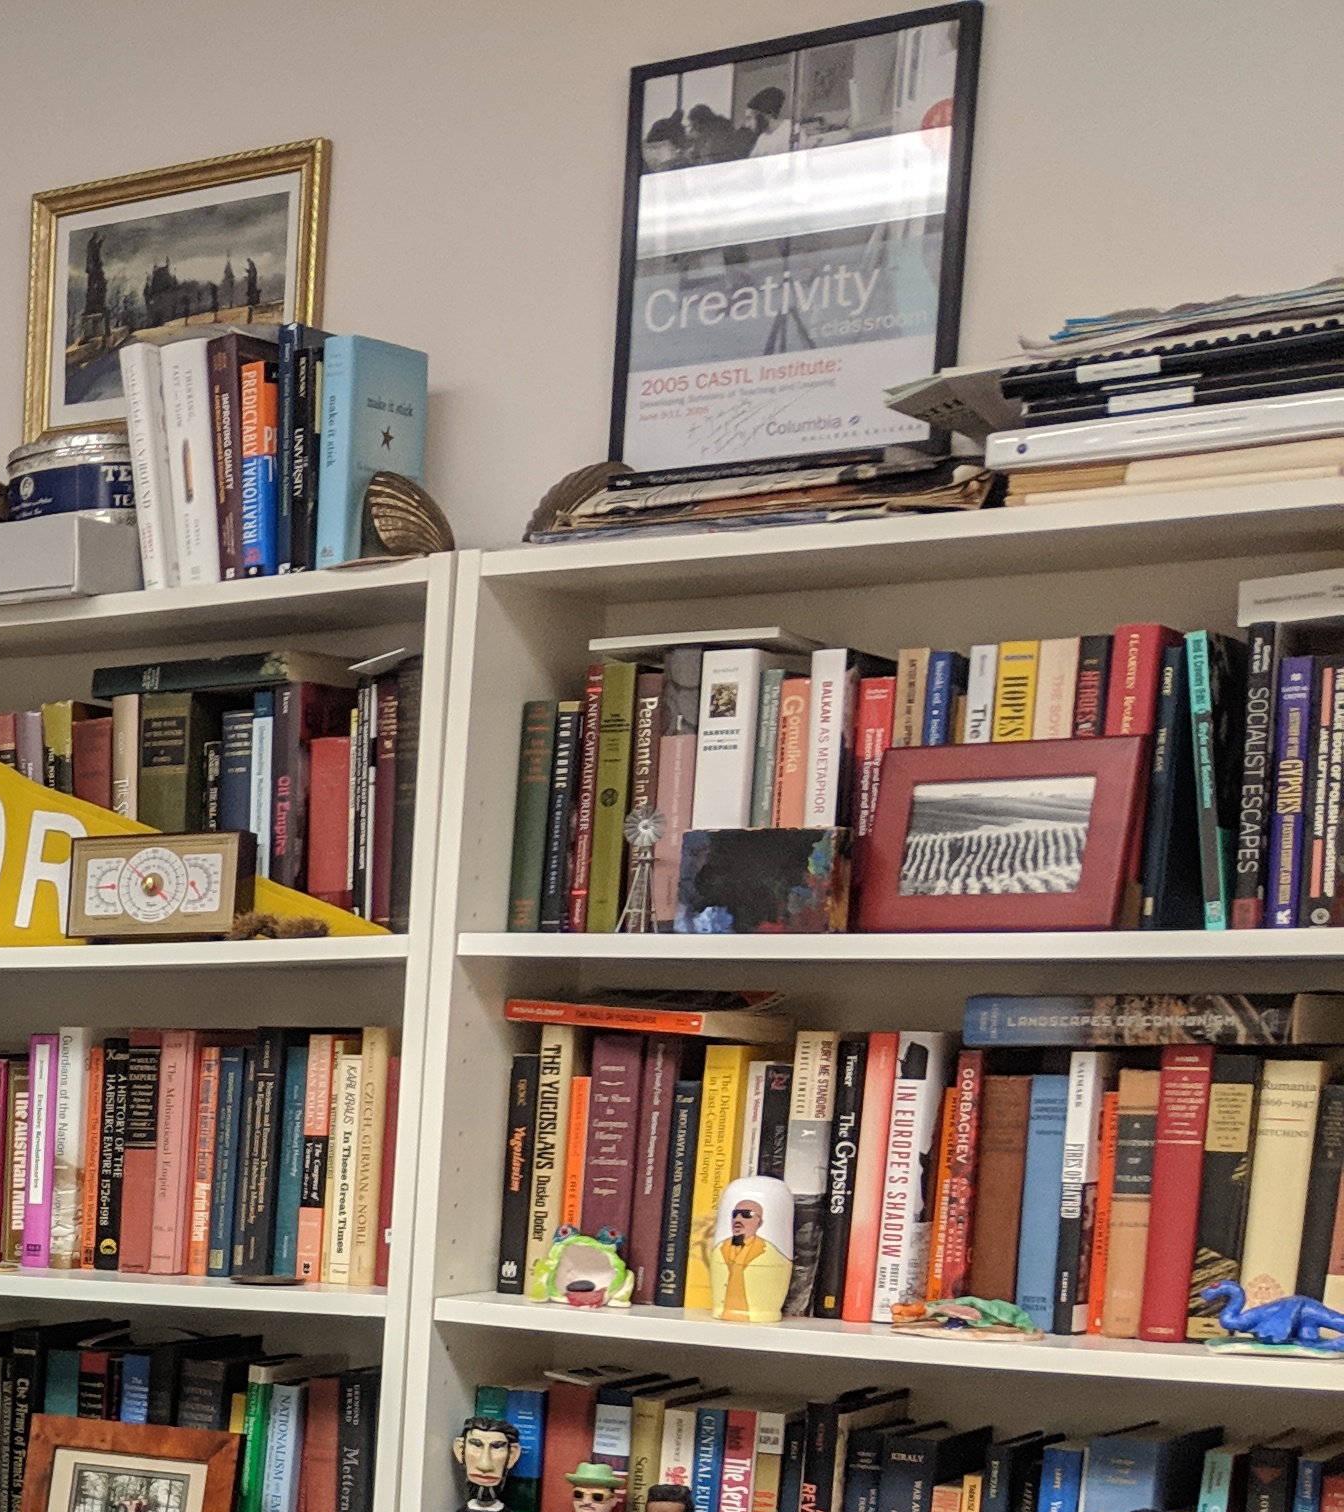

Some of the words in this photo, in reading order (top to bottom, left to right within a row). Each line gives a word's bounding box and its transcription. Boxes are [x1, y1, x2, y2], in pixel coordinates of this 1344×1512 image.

[643, 264, 880, 334] Creativity
[641, 376, 689, 397] 2005
[696, 369, 753, 394] CASTL
[760, 359, 842, 382] Institute:
[243, 370, 258, 457] PREDICTABLY
[766, 414, 842, 439] Columbia
[242, 458, 258, 543] IRRATIONAL
[820, 680, 833, 724] BALKAN
[967, 704, 988, 738] The
[997, 675, 1029, 738] HOPES
[633, 696, 659, 775] Peasants
[702, 728, 741, 736] HARVEST
[782, 694, 805, 774] Gomulka
[1242, 687, 1269, 776] SOCIALIST
[813, 745, 829, 814] METAPHOR
[1276, 759, 1303, 814] GYPSIES
[577, 788, 592, 831] ORDER
[1237, 784, 1263, 874] ESCAPES
[1006, 1014, 1112, 1027] LANDSCAPES
[60, 1035, 73, 1087] Guardians
[543, 1043, 562, 1076] THE
[843, 1055, 858, 1087] Fraser
[103, 1074, 116, 1133] HABSBURG
[116, 1085, 126, 1134] HISTORY
[815, 1079, 829, 1119] STANDING
[1260, 1080, 1317, 1093] Rumania
[56, 1122, 69, 1156] Nation
[535, 1078, 559, 1171] YUGOSLAVS
[720, 1094, 730, 1140] Dilemmas
[838, 1112, 856, 1138] The
[956, 1067, 975, 1164] GORBACHEV
[102, 1136, 112, 1175] EMPIRE
[340, 1146, 351, 1181] These
[357, 1134, 372, 1192] GERMAN
[700, 1151, 713, 1184] Europe
[890, 1107, 916, 1185] EUROPE'S
[338, 1182, 350, 1216] Great
[534, 1175, 551, 1209] Dusko
[830, 1141, 857, 1214] Gypsies
[100, 1178, 111, 1226] 1526-1918
[355, 1204, 367, 1247] NOBLE
[882, 1189, 908, 1259] SHADOW
[336, 1217, 347, 1254] Times
[530, 1210, 550, 1242] Doder
[272, 1393, 292, 1480] NATIONALISM
[699, 1414, 716, 1484] CENTRAL
